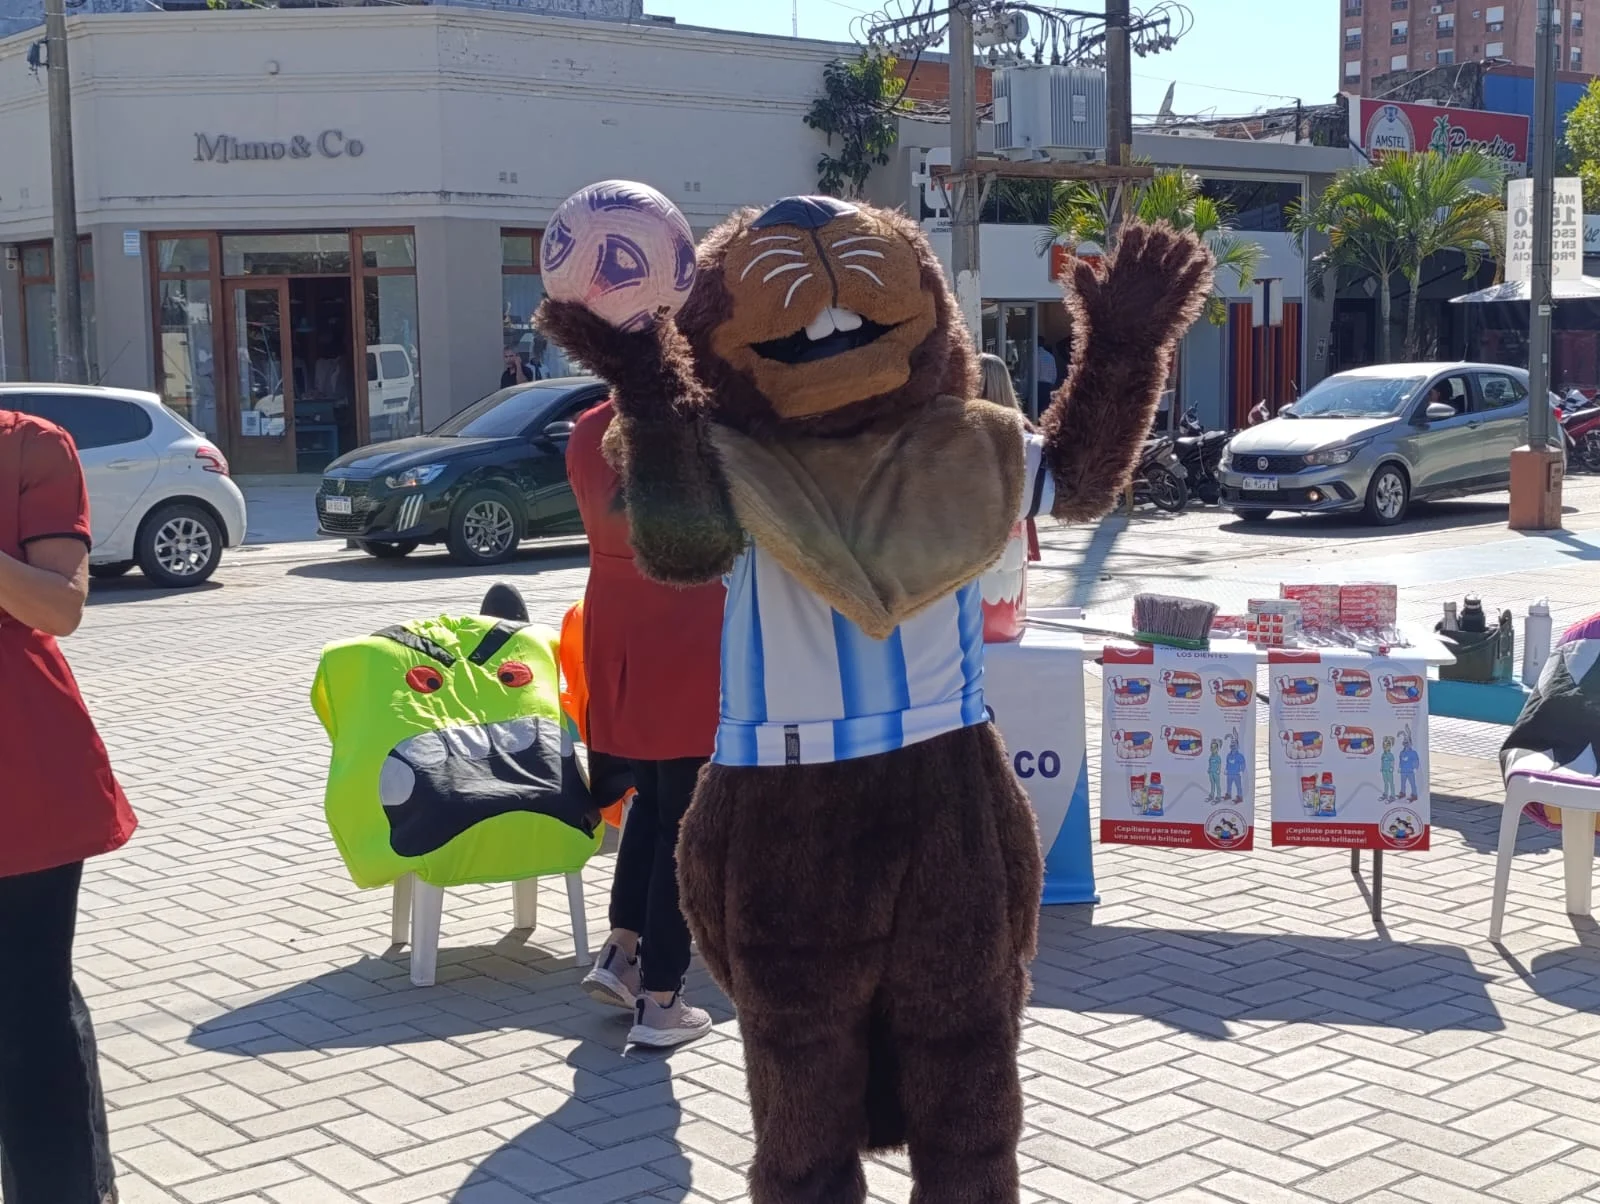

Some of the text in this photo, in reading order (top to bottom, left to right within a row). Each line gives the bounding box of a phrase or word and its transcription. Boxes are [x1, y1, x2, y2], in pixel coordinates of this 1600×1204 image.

[1375, 135, 1405, 149] AMSTEL
[1177, 651, 1229, 659] LOS DIENTES
[1152, 827, 1169, 835] para
[1170, 828, 1191, 836] tener
[1325, 828, 1342, 836] para
[1344, 828, 1365, 836] tener
[1130, 833, 1157, 841] sonrisa
[1158, 835, 1193, 844] brillante!
[1331, 836, 1367, 845] brillante!
